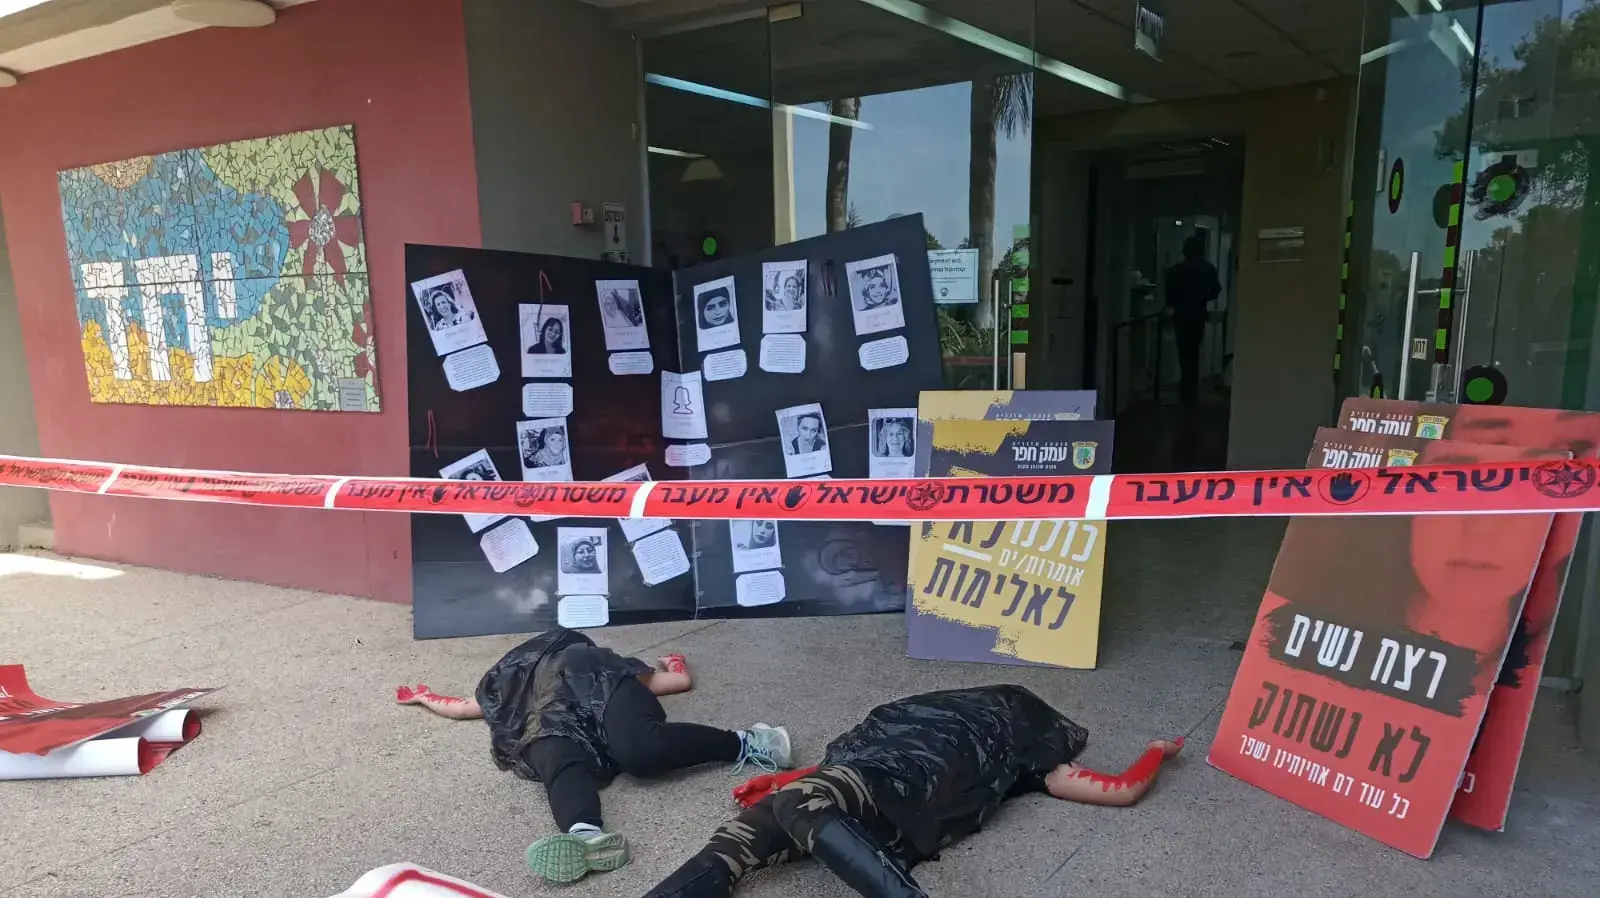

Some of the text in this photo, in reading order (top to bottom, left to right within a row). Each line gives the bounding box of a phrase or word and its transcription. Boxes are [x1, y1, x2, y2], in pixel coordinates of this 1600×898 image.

[1012, 447, 1067, 463] עמק חפר
[1322, 449, 1347, 468] חפר
[347, 482, 626, 503] משטרת ישראל אין מעבר
[660, 483, 1075, 509] משטרת ישראל אין מעבר
[1125, 467, 1530, 507] ישראל אין מעבר
[998, 547, 1085, 587] אומרות/ים
[922, 556, 1076, 631] לאלימות
[1284, 613, 1448, 699] רצח נשים
[1247, 680, 1432, 784] לא נשתוק
[1239, 734, 1411, 820] כל עוד דם אחיותינו נשפך
